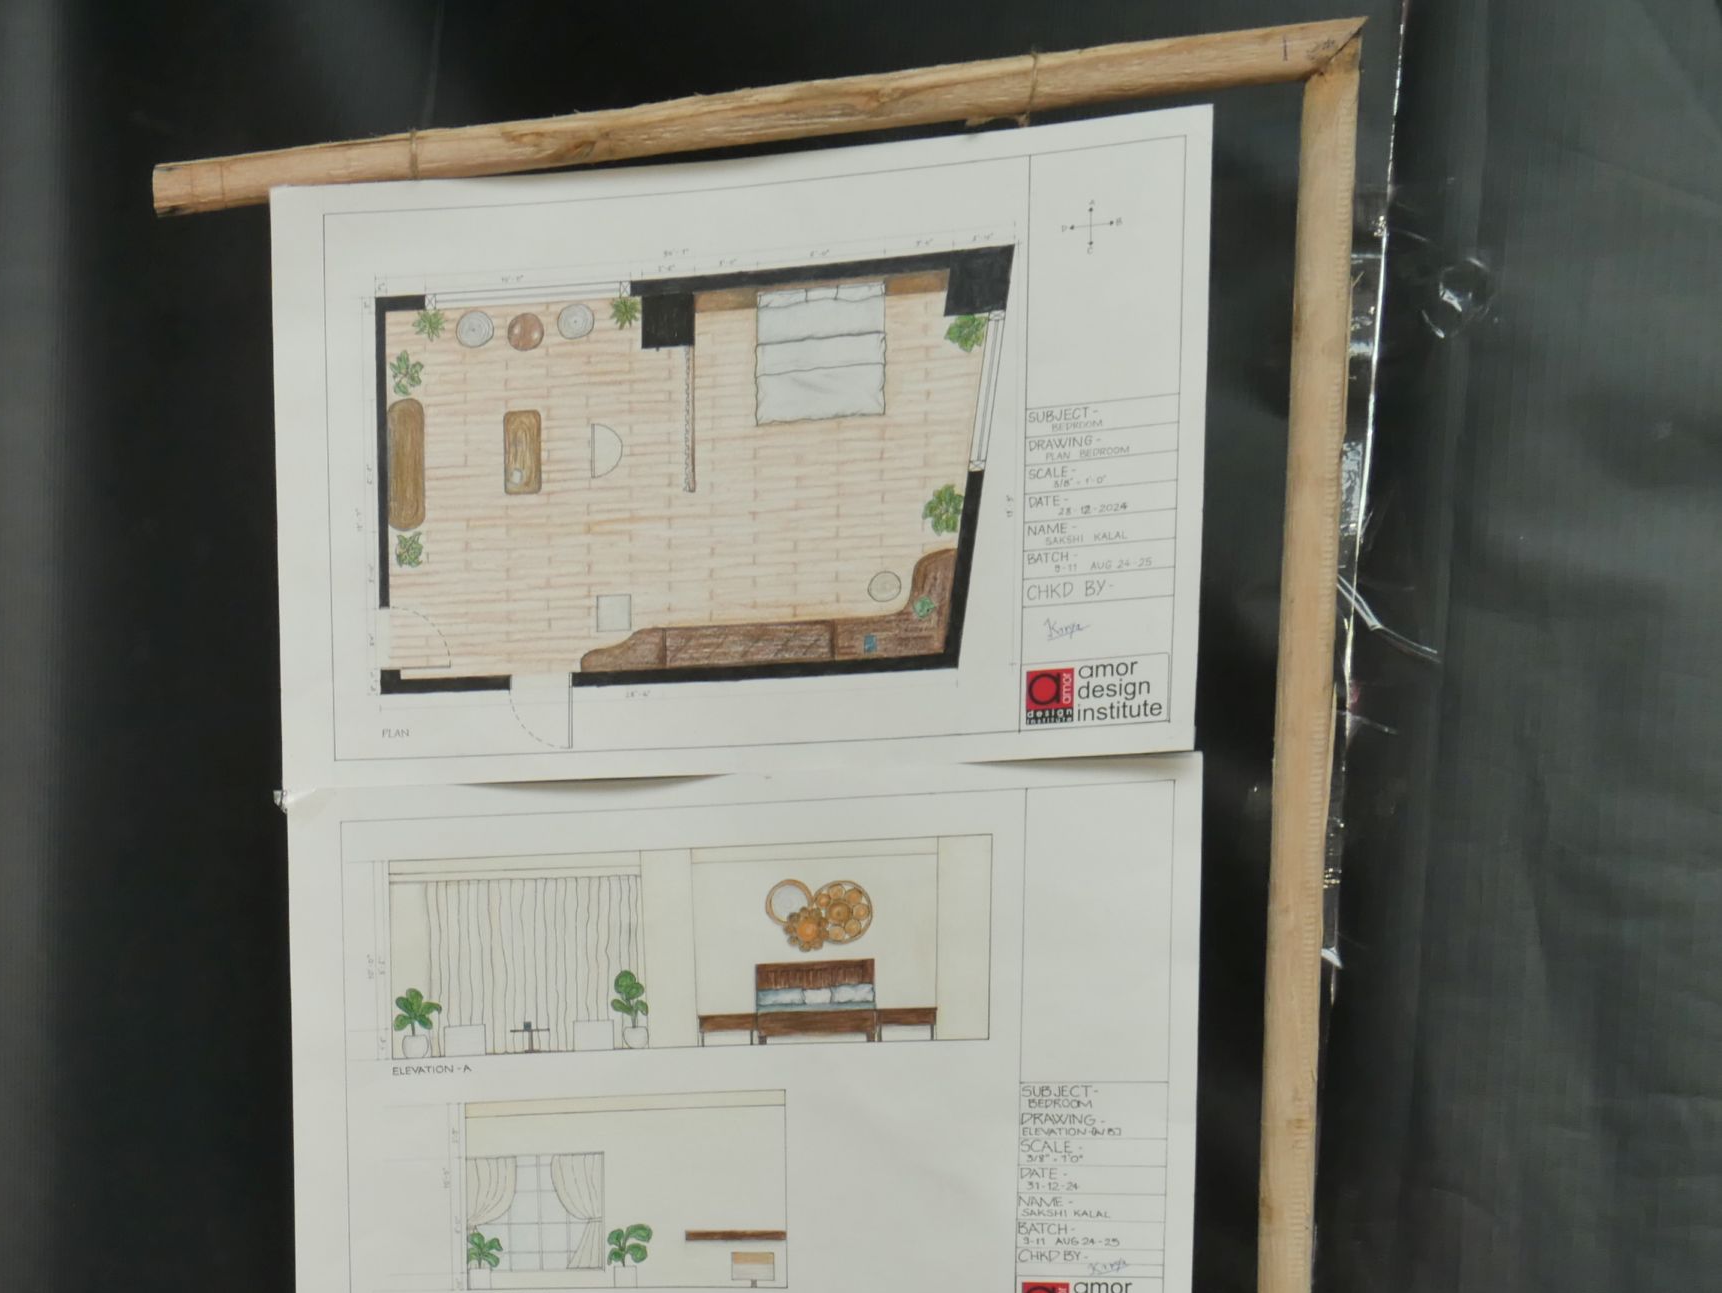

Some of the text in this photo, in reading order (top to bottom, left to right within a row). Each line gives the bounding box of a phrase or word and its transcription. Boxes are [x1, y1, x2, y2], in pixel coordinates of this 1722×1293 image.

[1026, 581, 1074, 600] CHKD
[1078, 661, 1138, 679] amor
[1078, 678, 1151, 701] design
[1078, 699, 1163, 721] institute
[1018, 1249, 1060, 1262] CHKD
